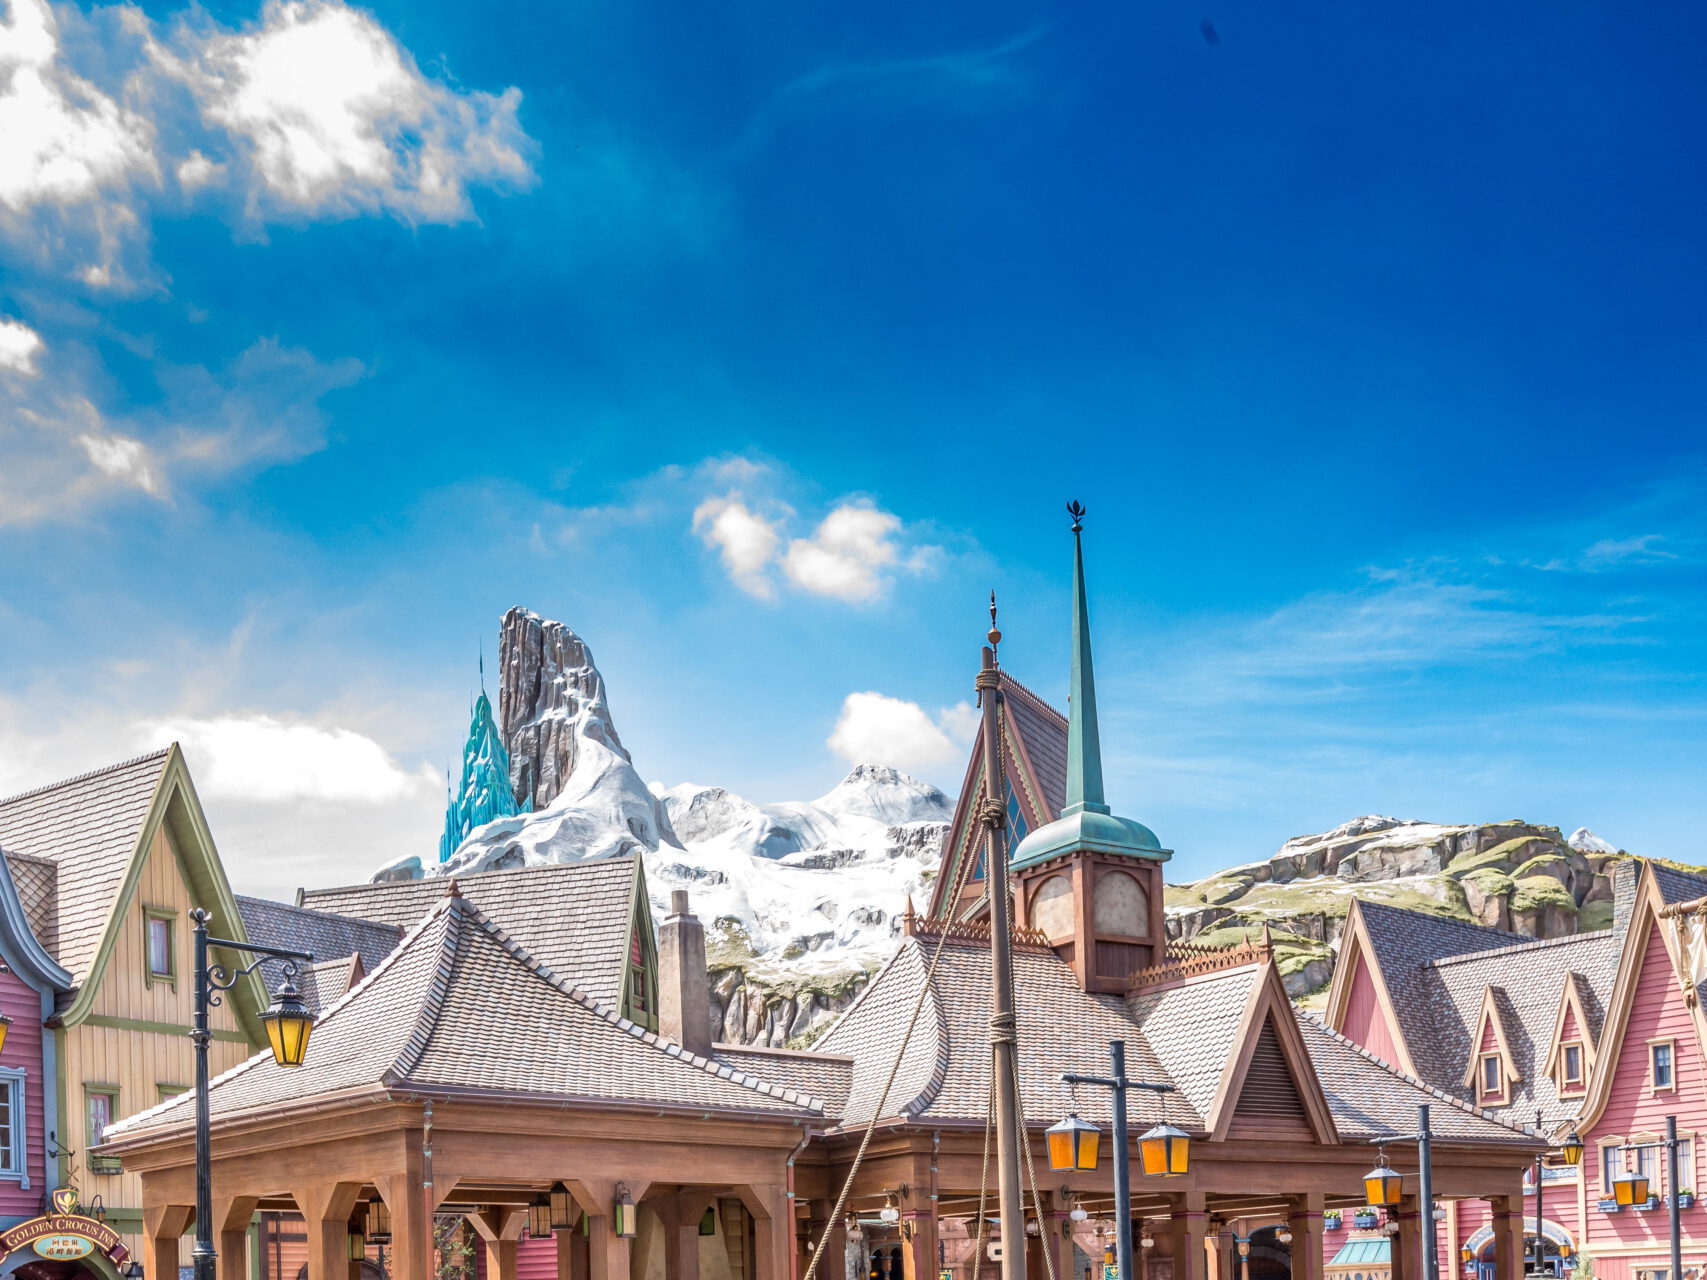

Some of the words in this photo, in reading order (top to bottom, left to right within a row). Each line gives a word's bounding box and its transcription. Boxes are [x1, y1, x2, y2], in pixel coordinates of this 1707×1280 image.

[6, 1222, 53, 1247] GOLDEN
[56, 1219, 98, 1236] CROCUS
[99, 1231, 116, 1247] INN
